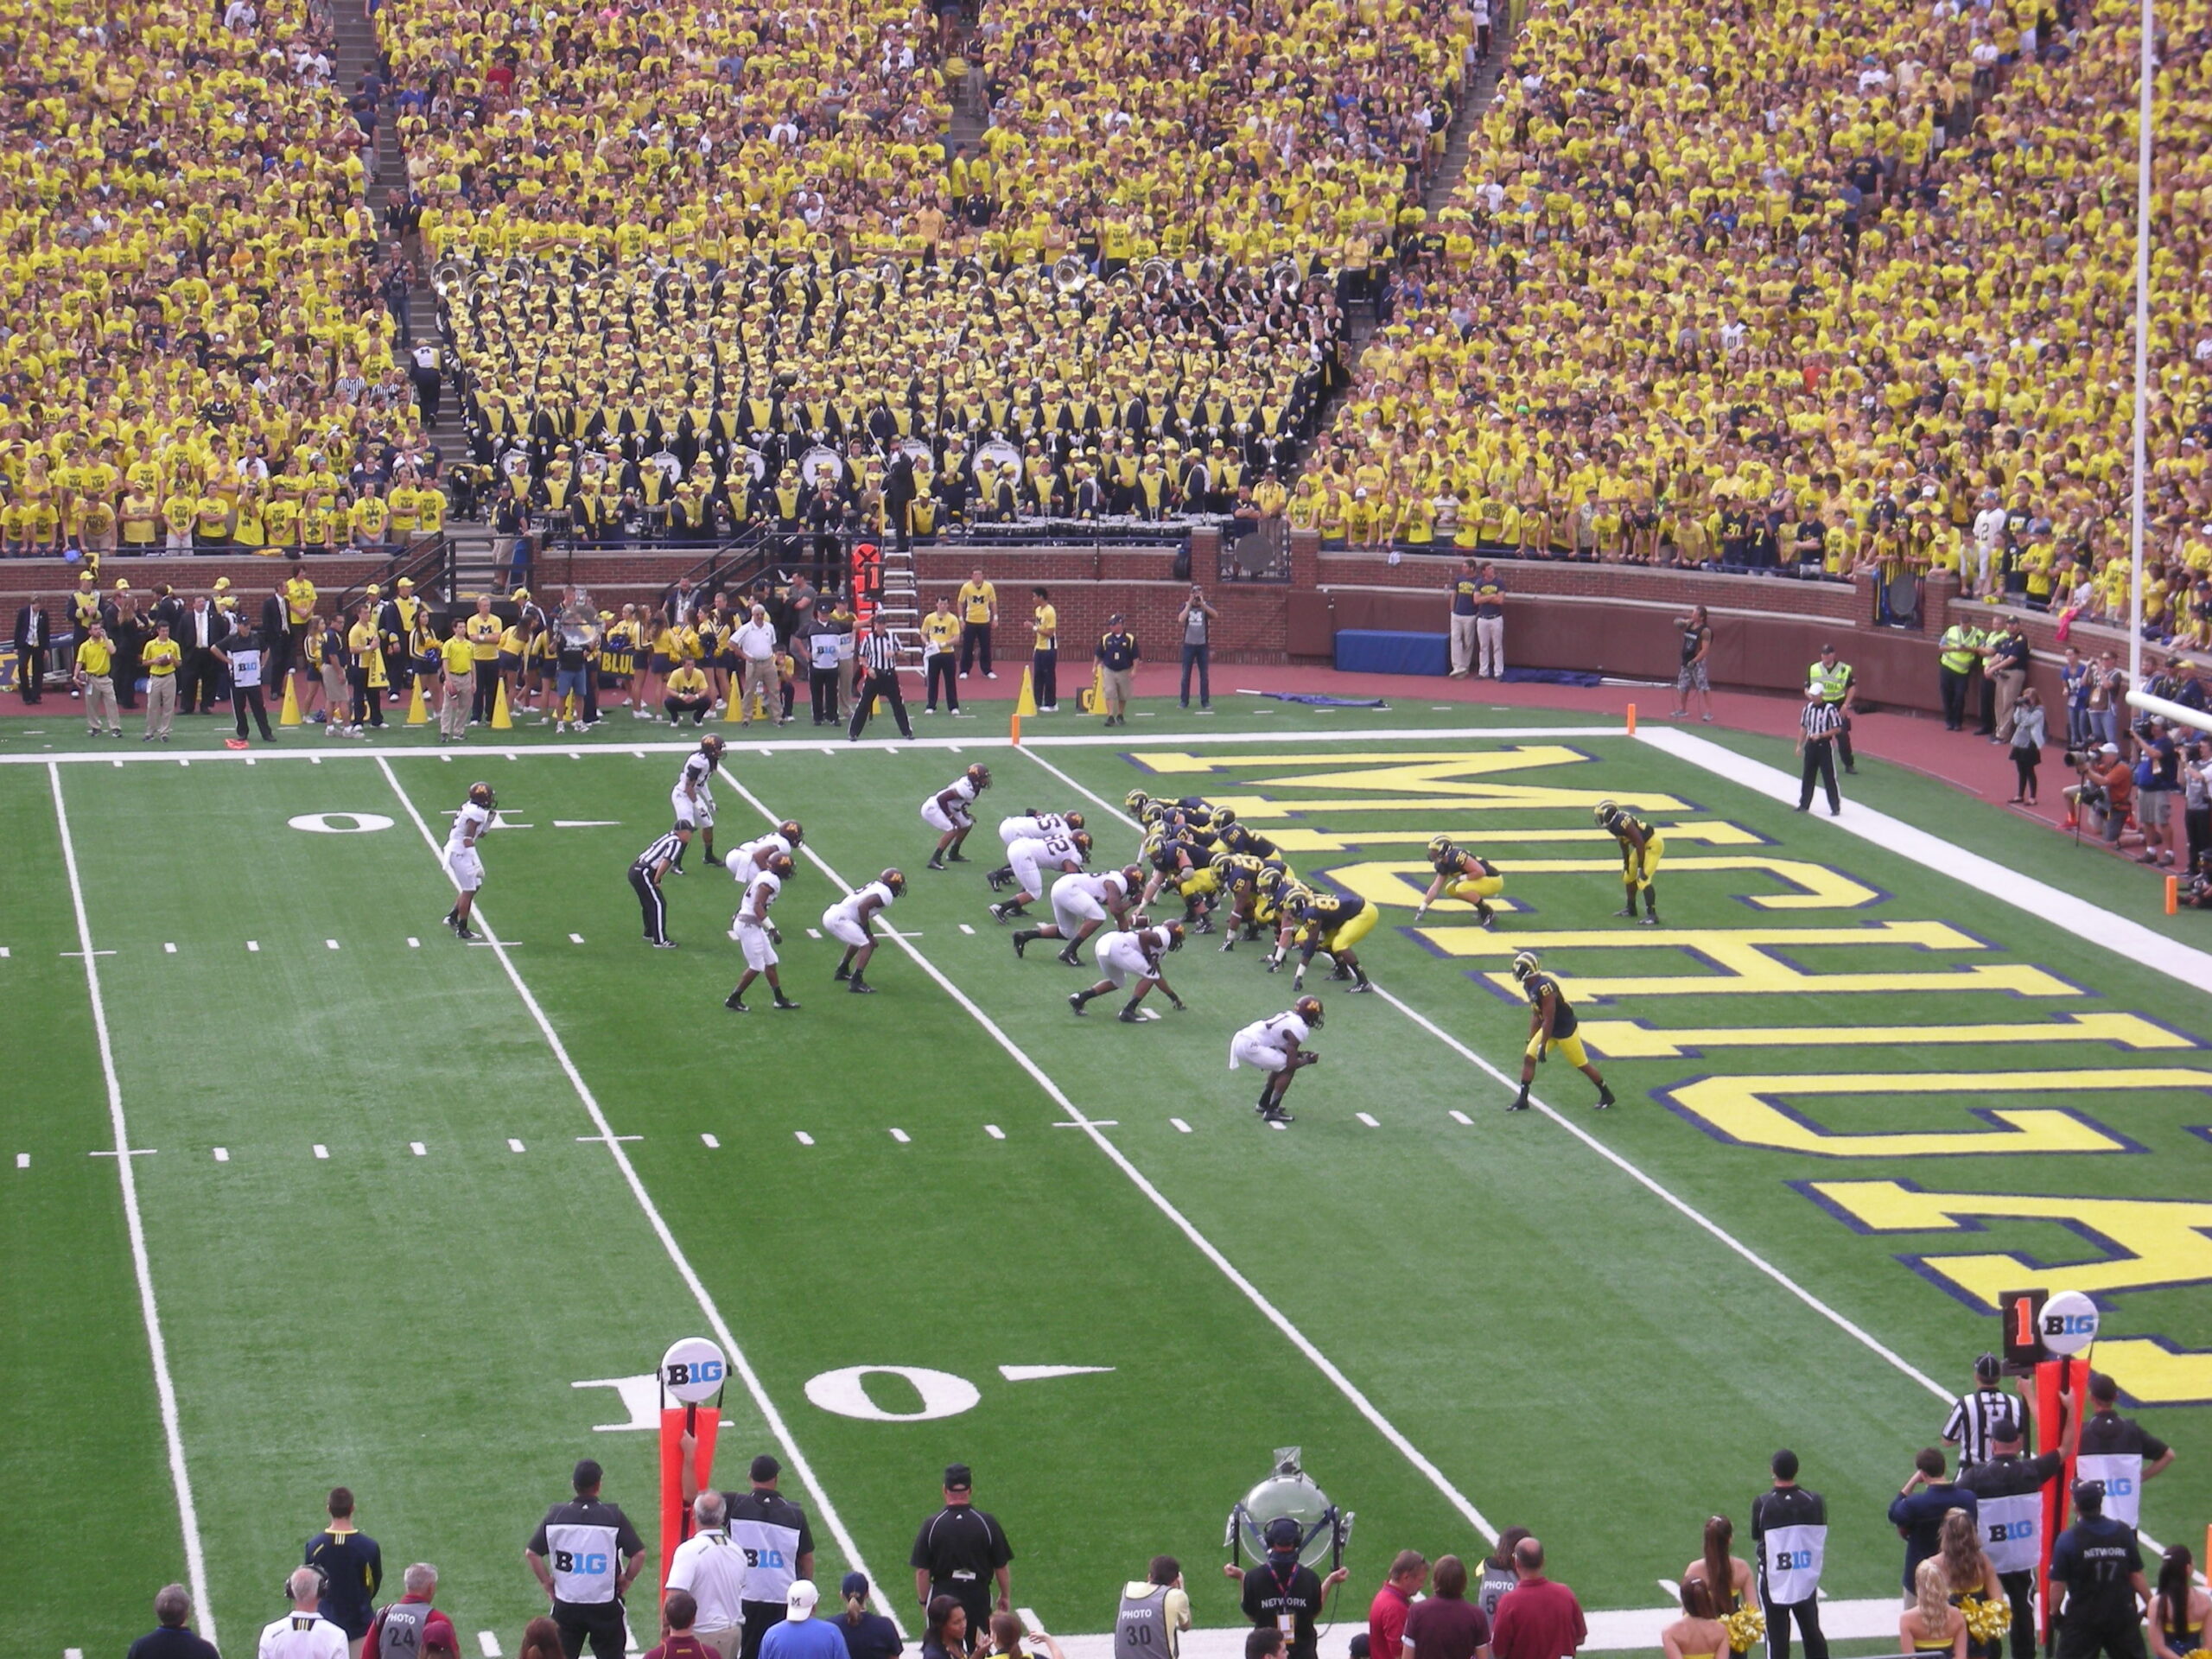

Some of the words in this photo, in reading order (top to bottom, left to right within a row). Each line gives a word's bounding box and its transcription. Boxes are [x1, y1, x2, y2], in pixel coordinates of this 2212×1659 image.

[1755, 528, 1764, 546] 7
[871, 567, 880, 588] 1
[973, 594, 984, 603] M
[480, 625, 493, 634] M
[934, 626, 946, 634] M
[1126, 744, 2212, 1408] MICHIGA
[2014, 1297, 2035, 1346] 1
[2083, 1548, 2126, 1559] NETWORK
[2094, 1561, 2120, 1582] 17
[1484, 1580, 1515, 1592] PHOTO
[791, 1596, 802, 1607] M
[387, 1611, 416, 1625] PHOTO
[1122, 1608, 1153, 1620] PHOTO
[388, 1626, 416, 1647] 24
[1126, 1624, 1152, 1647] 30
